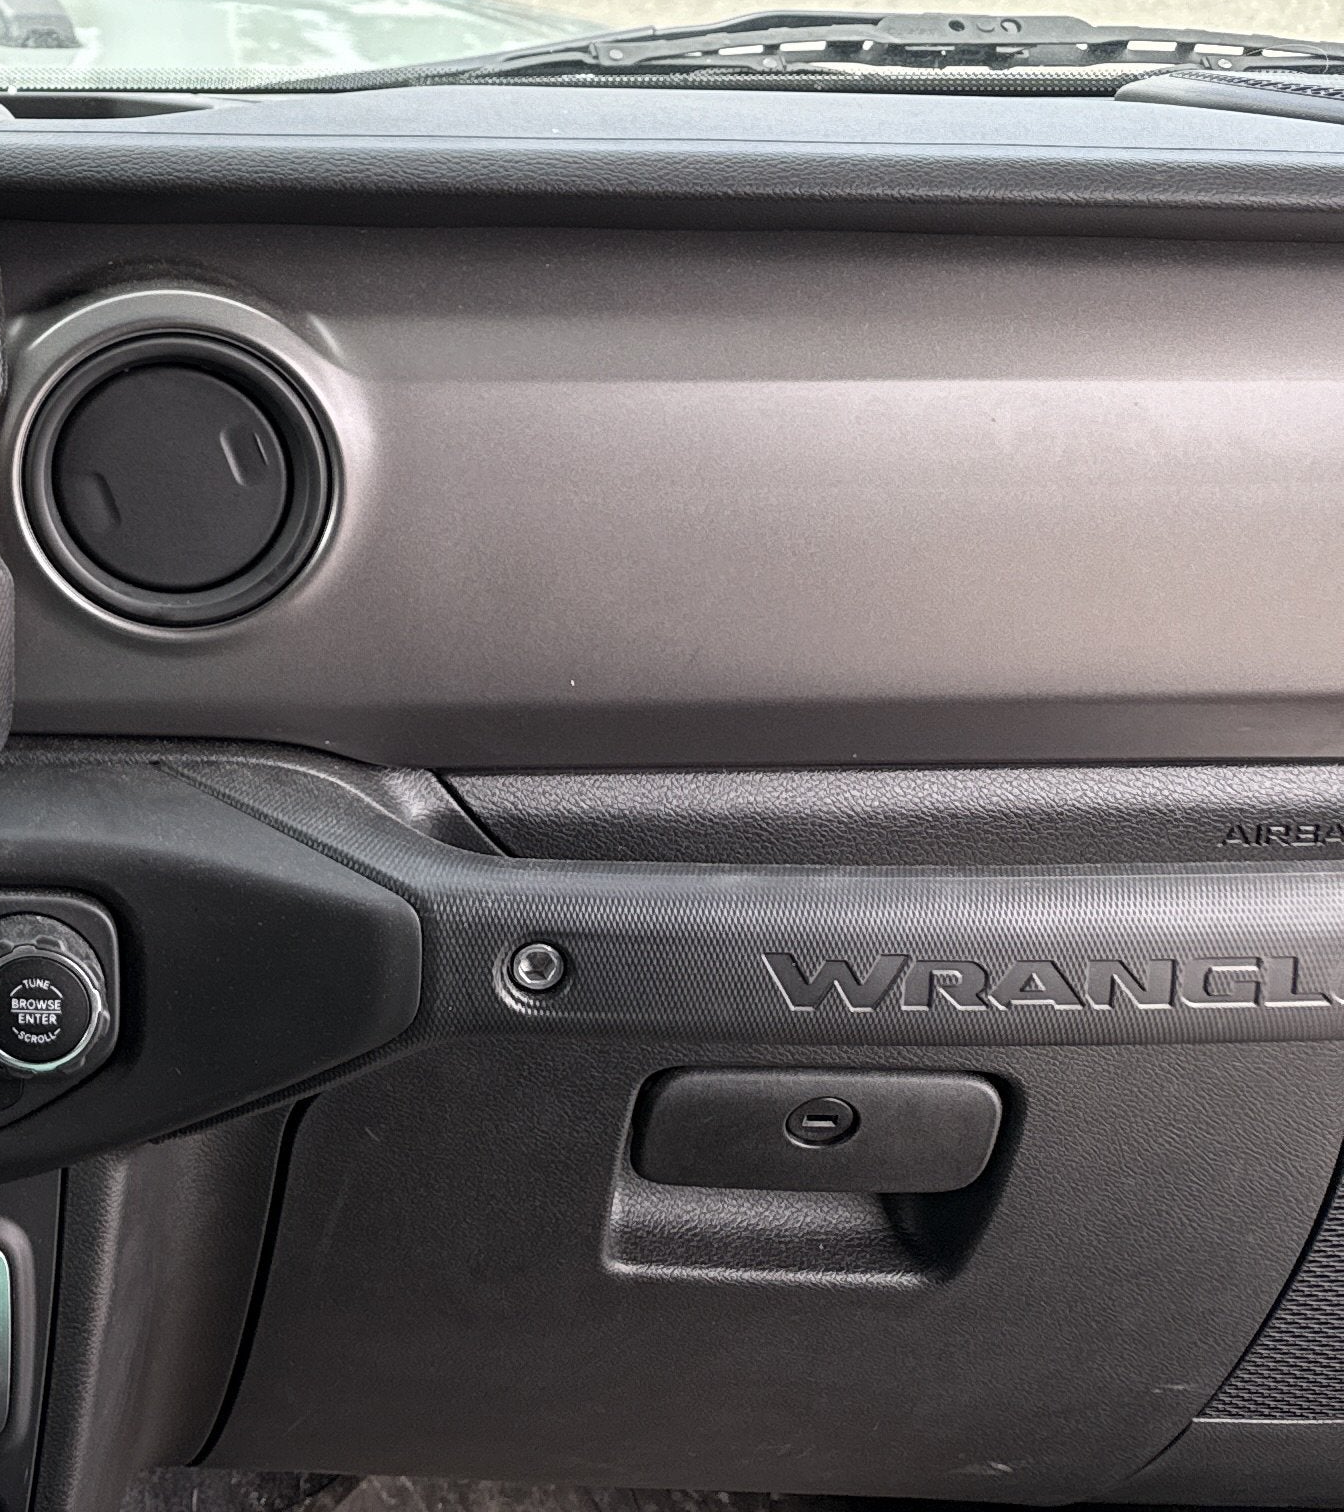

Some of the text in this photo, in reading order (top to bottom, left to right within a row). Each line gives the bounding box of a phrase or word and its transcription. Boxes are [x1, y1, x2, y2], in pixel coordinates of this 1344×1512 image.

[21, 977, 52, 991] TUNE
[760, 951, 1344, 1014] WRANGL
[11, 997, 62, 1010] BROWSE
[17, 1013, 58, 1026] ENTER
[16, 1030, 58, 1044] SCROLL
